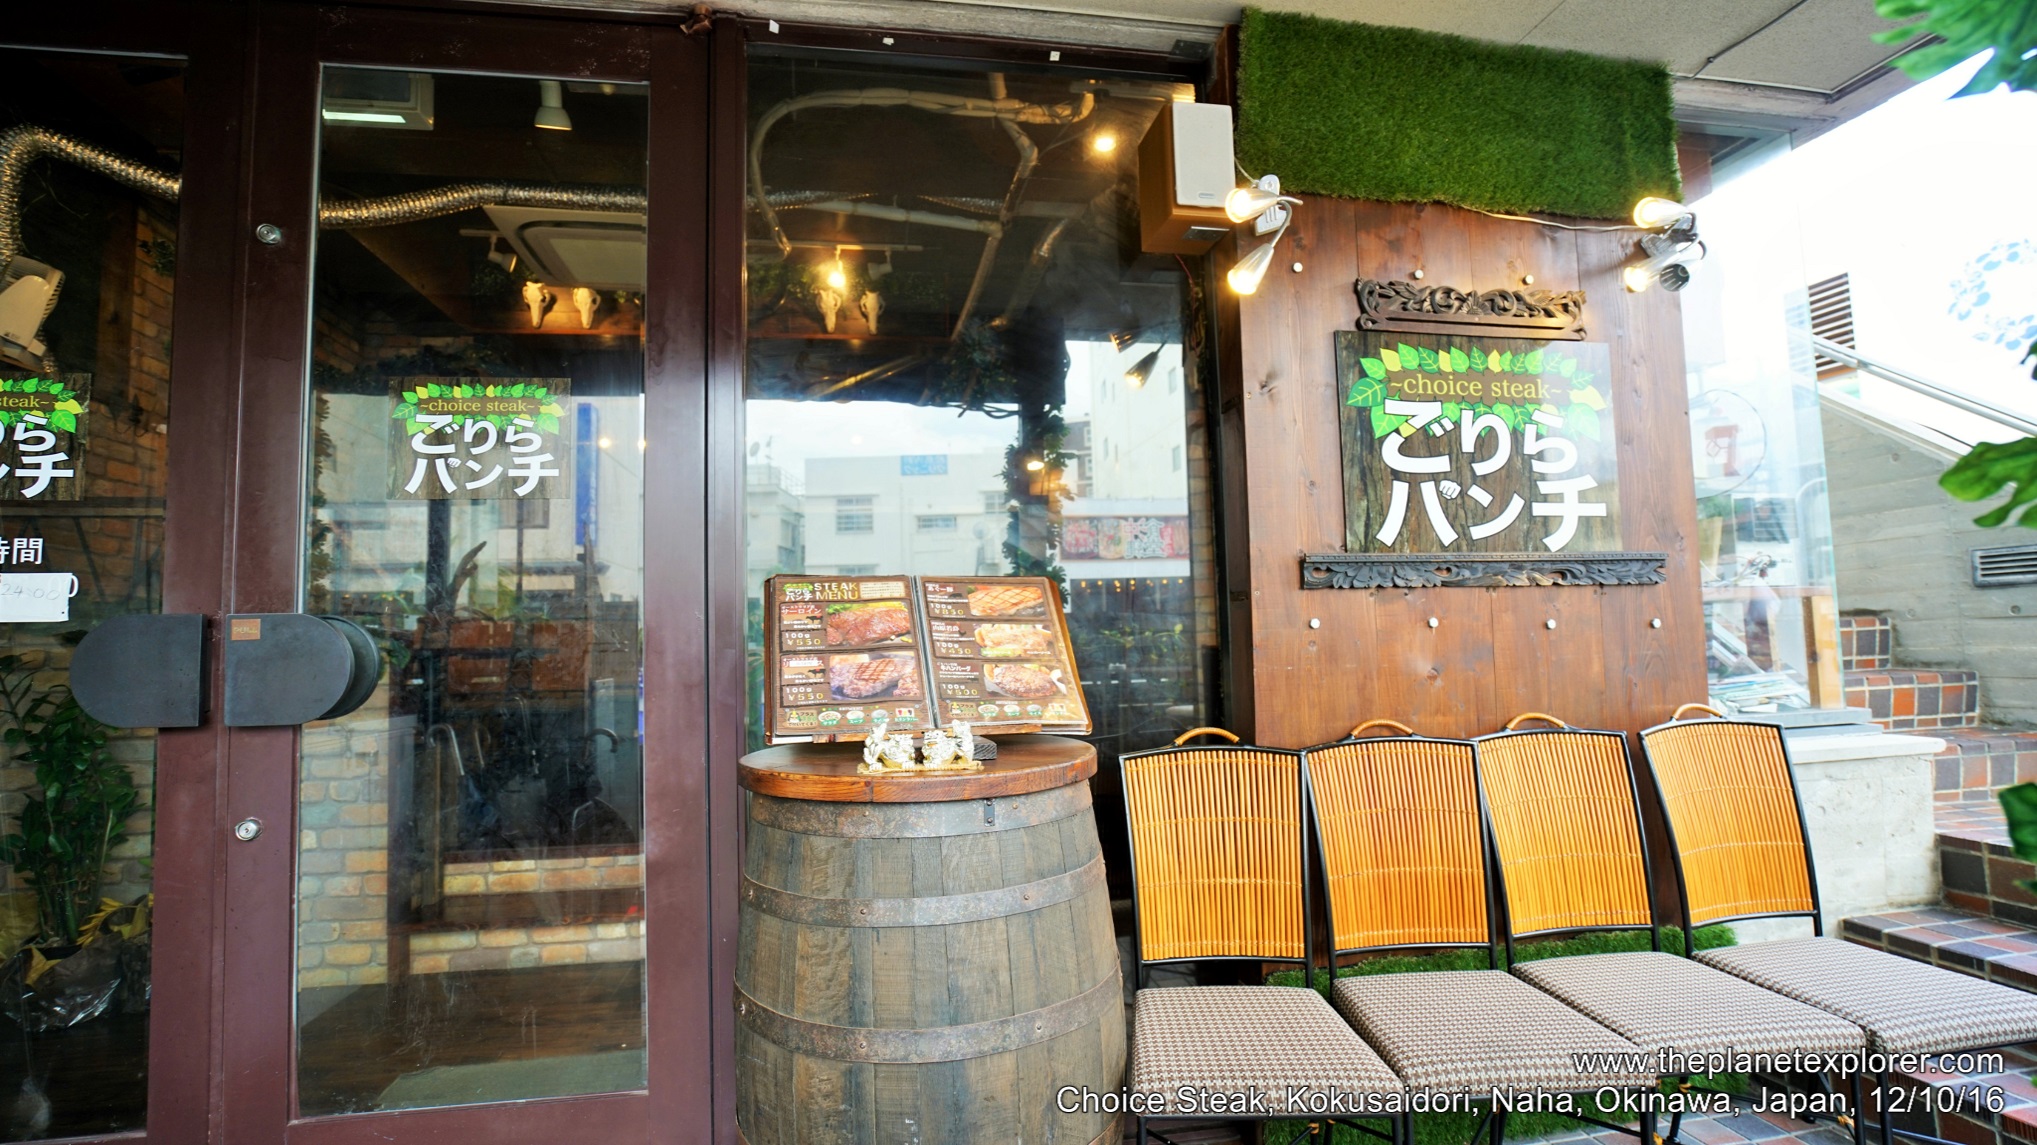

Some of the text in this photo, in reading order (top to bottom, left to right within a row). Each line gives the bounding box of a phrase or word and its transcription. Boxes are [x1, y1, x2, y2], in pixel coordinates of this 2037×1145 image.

[411, 414, 543, 455] ごりら
[1381, 398, 1579, 477] ごりら
[814, 582, 858, 591] STEAK
[815, 590, 859, 600] MENU
[781, 608, 822, 616] サーロイン
